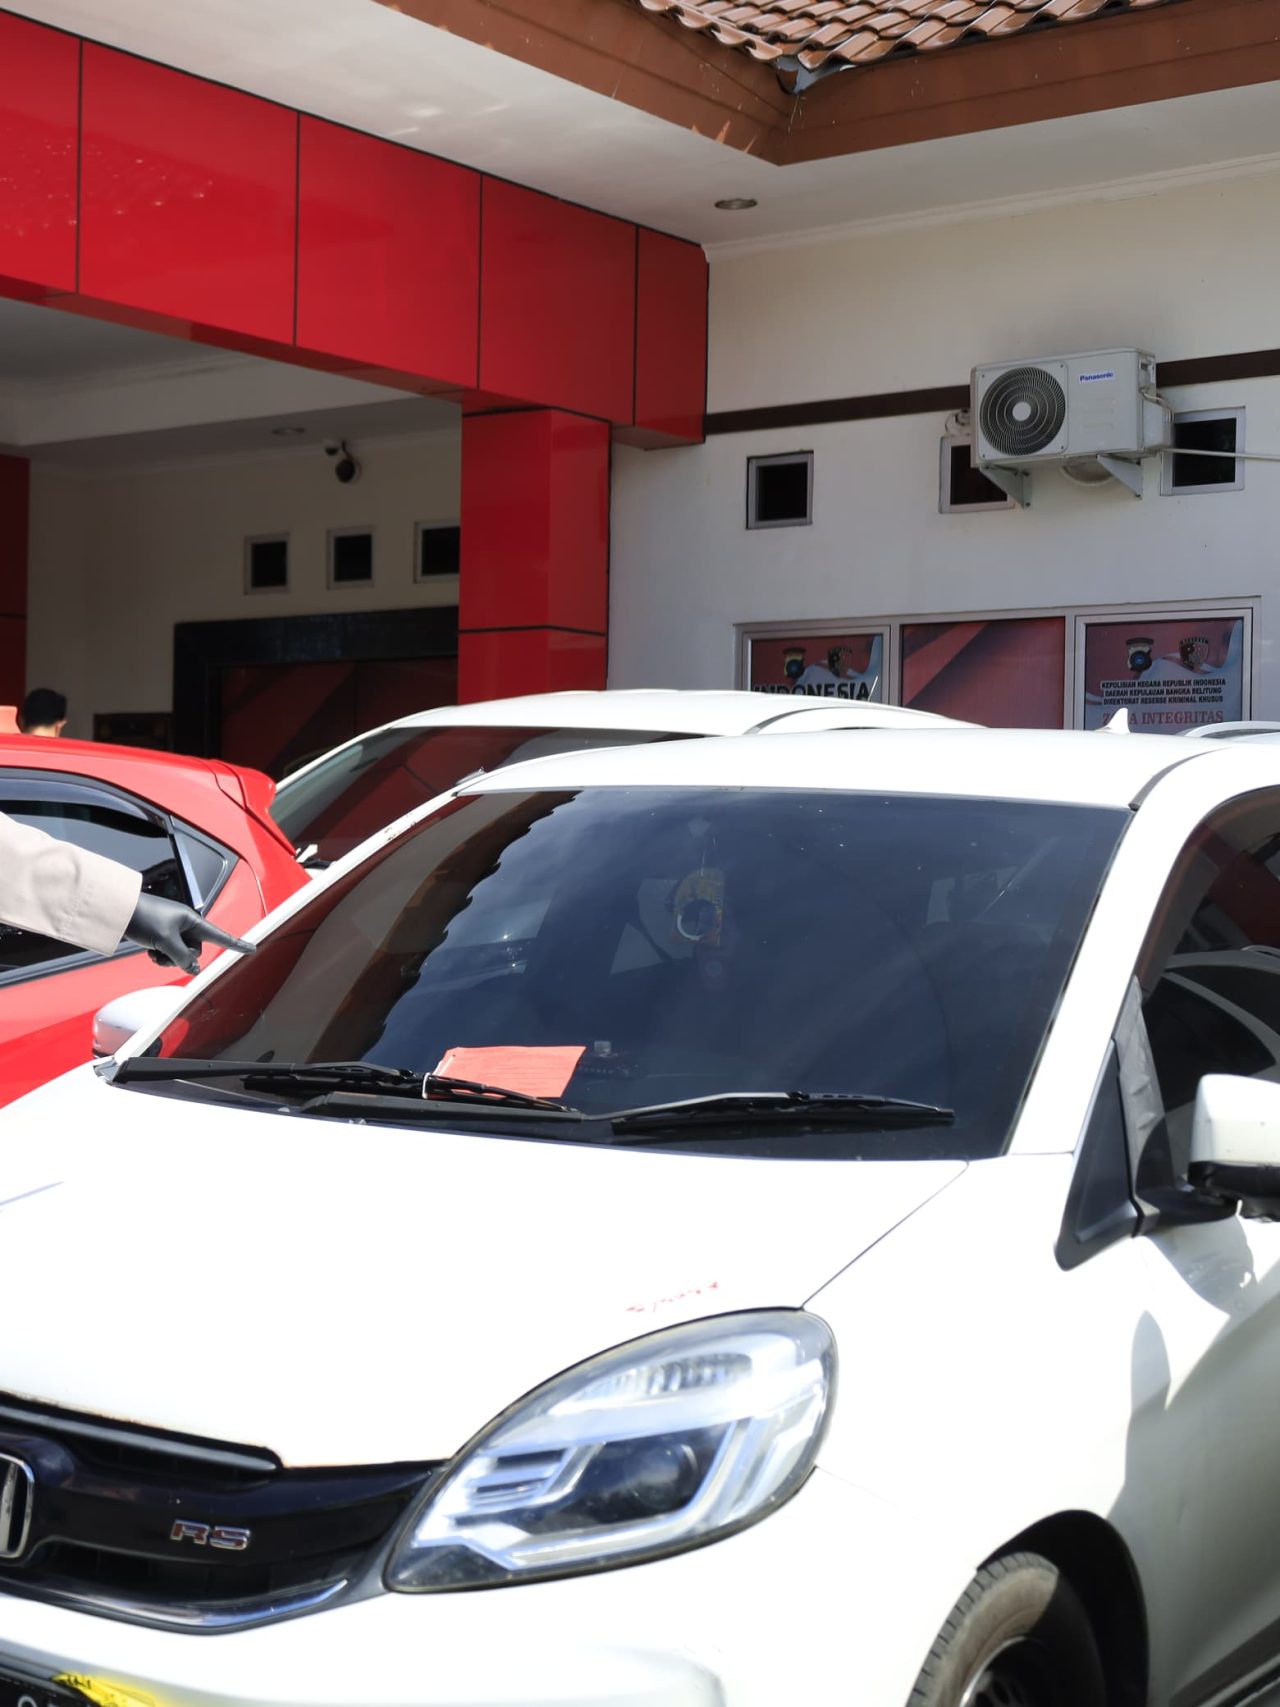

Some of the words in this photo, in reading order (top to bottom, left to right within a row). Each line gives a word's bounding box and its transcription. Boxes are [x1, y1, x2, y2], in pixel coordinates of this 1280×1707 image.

[1079, 371, 1114, 382] Panasonic
[1101, 681, 1137, 689] KEPOLISIAN
[1137, 680, 1161, 688] NEGARA
[1162, 679, 1191, 687] REPUBLIK
[1193, 678, 1226, 686] INDONESIA
[1105, 689, 1129, 697] DAERAH
[1129, 688, 1164, 696] KEPULAUAN
[1166, 688, 1190, 696] BANGKA
[1192, 687, 1222, 695] BELITUNG
[1103, 711, 1138, 726] ZA
[1142, 711, 1224, 725] INTEGRITAS
[170, 1518, 251, 1551] RS
